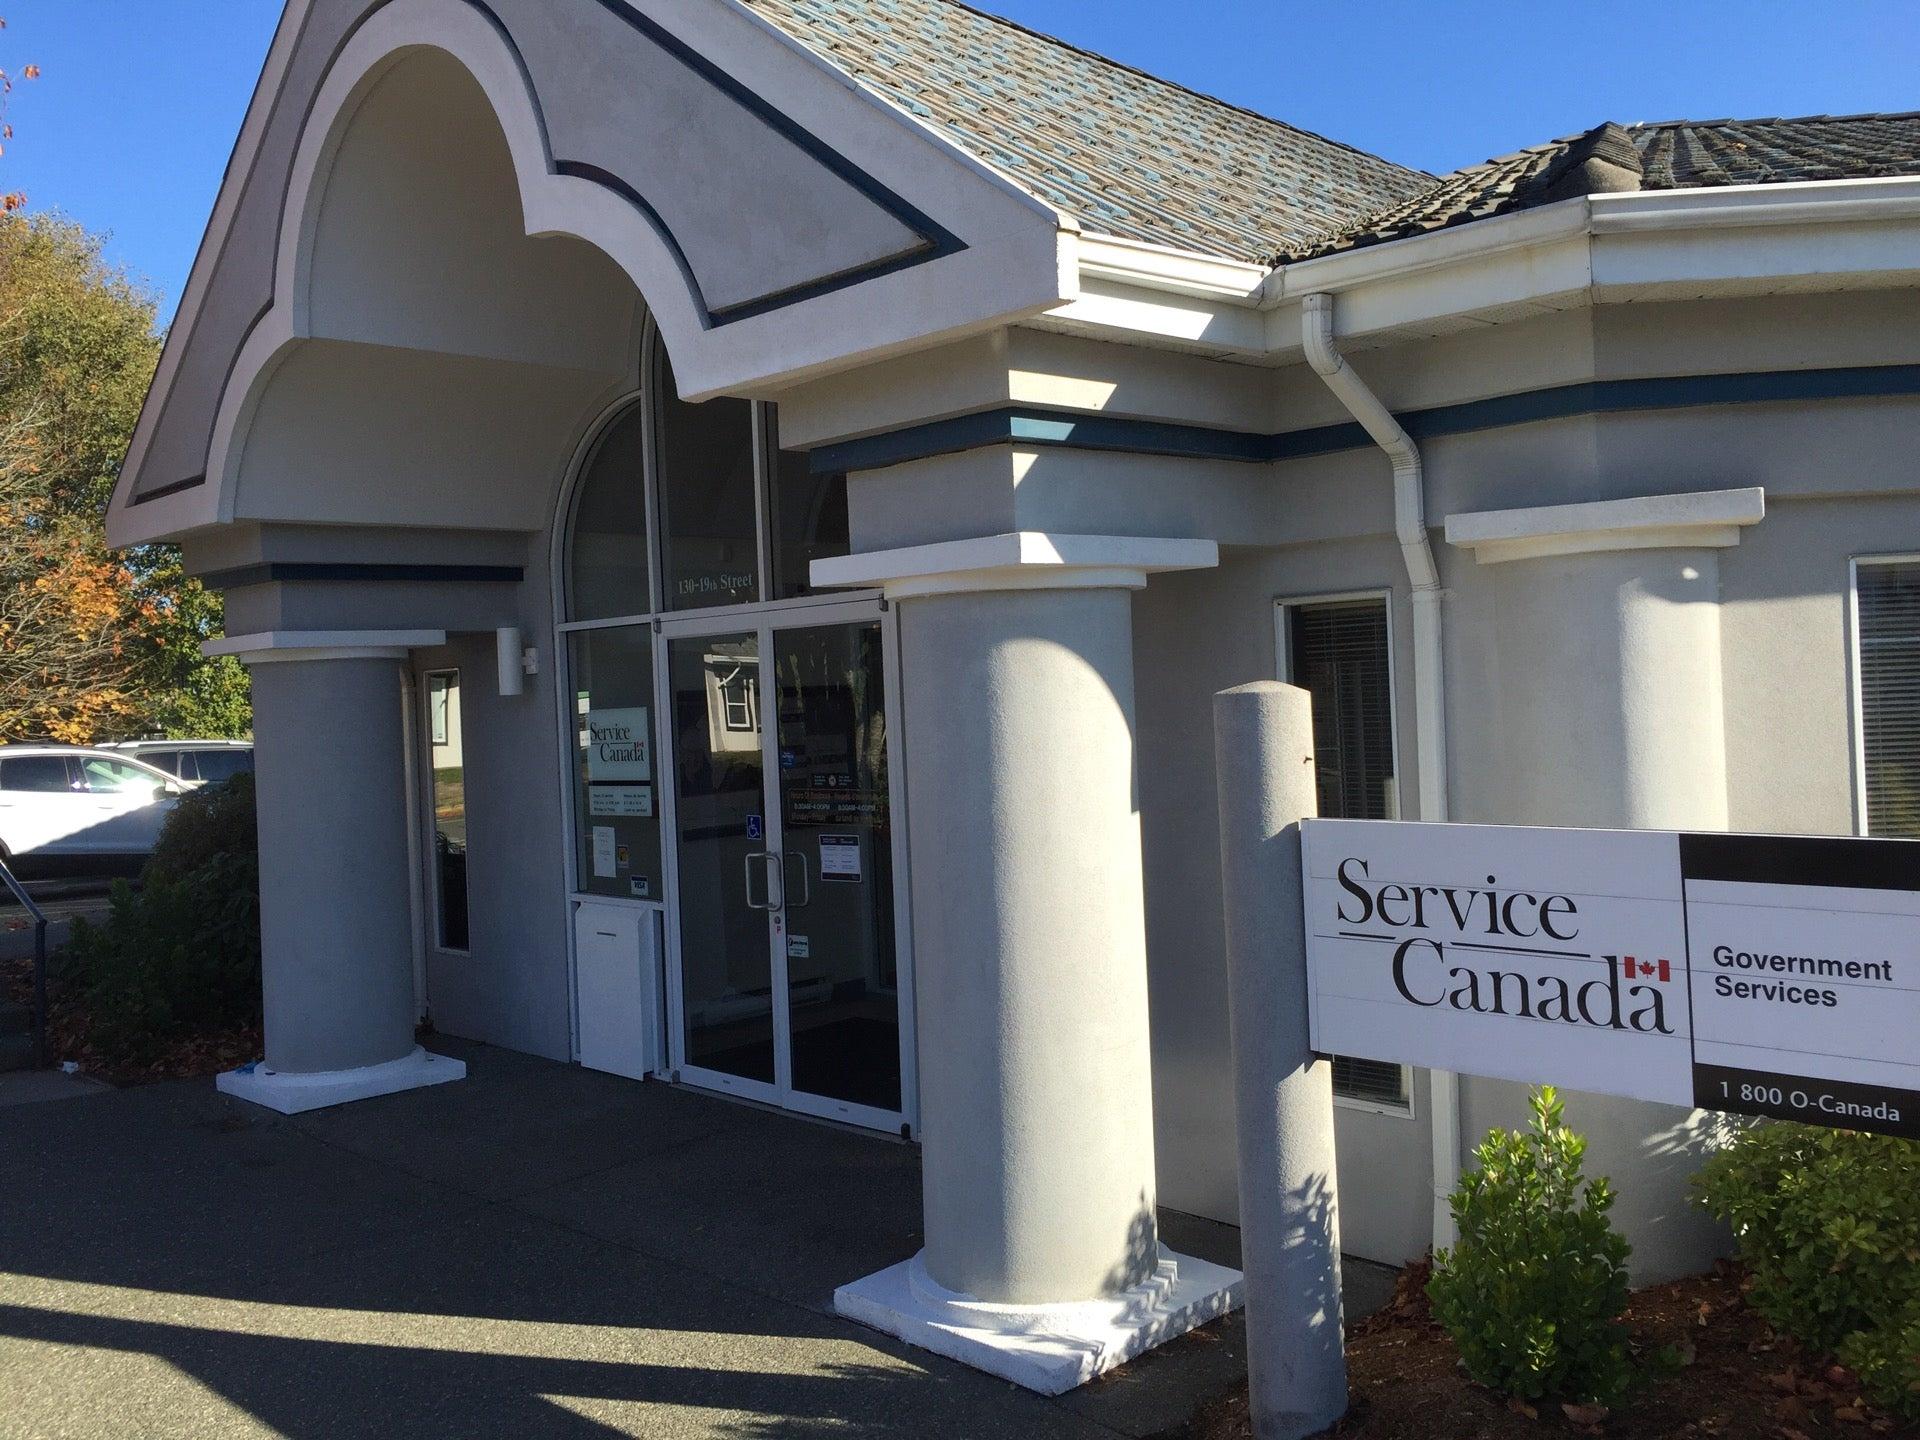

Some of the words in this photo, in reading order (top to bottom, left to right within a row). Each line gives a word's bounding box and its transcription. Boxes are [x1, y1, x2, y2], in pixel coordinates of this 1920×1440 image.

[720, 573, 753, 589] Street
[590, 721, 630, 741] Service
[600, 742, 645, 762] Canada
[1337, 857, 1579, 940] Service
[1713, 945, 1893, 981] Government
[1392, 937, 1675, 1034] Canada
[1715, 975, 1838, 1007] Services
[1720, 1081, 1729, 1098] 1
[1740, 1083, 1783, 1105] 800
[1789, 1091, 1900, 1122] O-Canada
